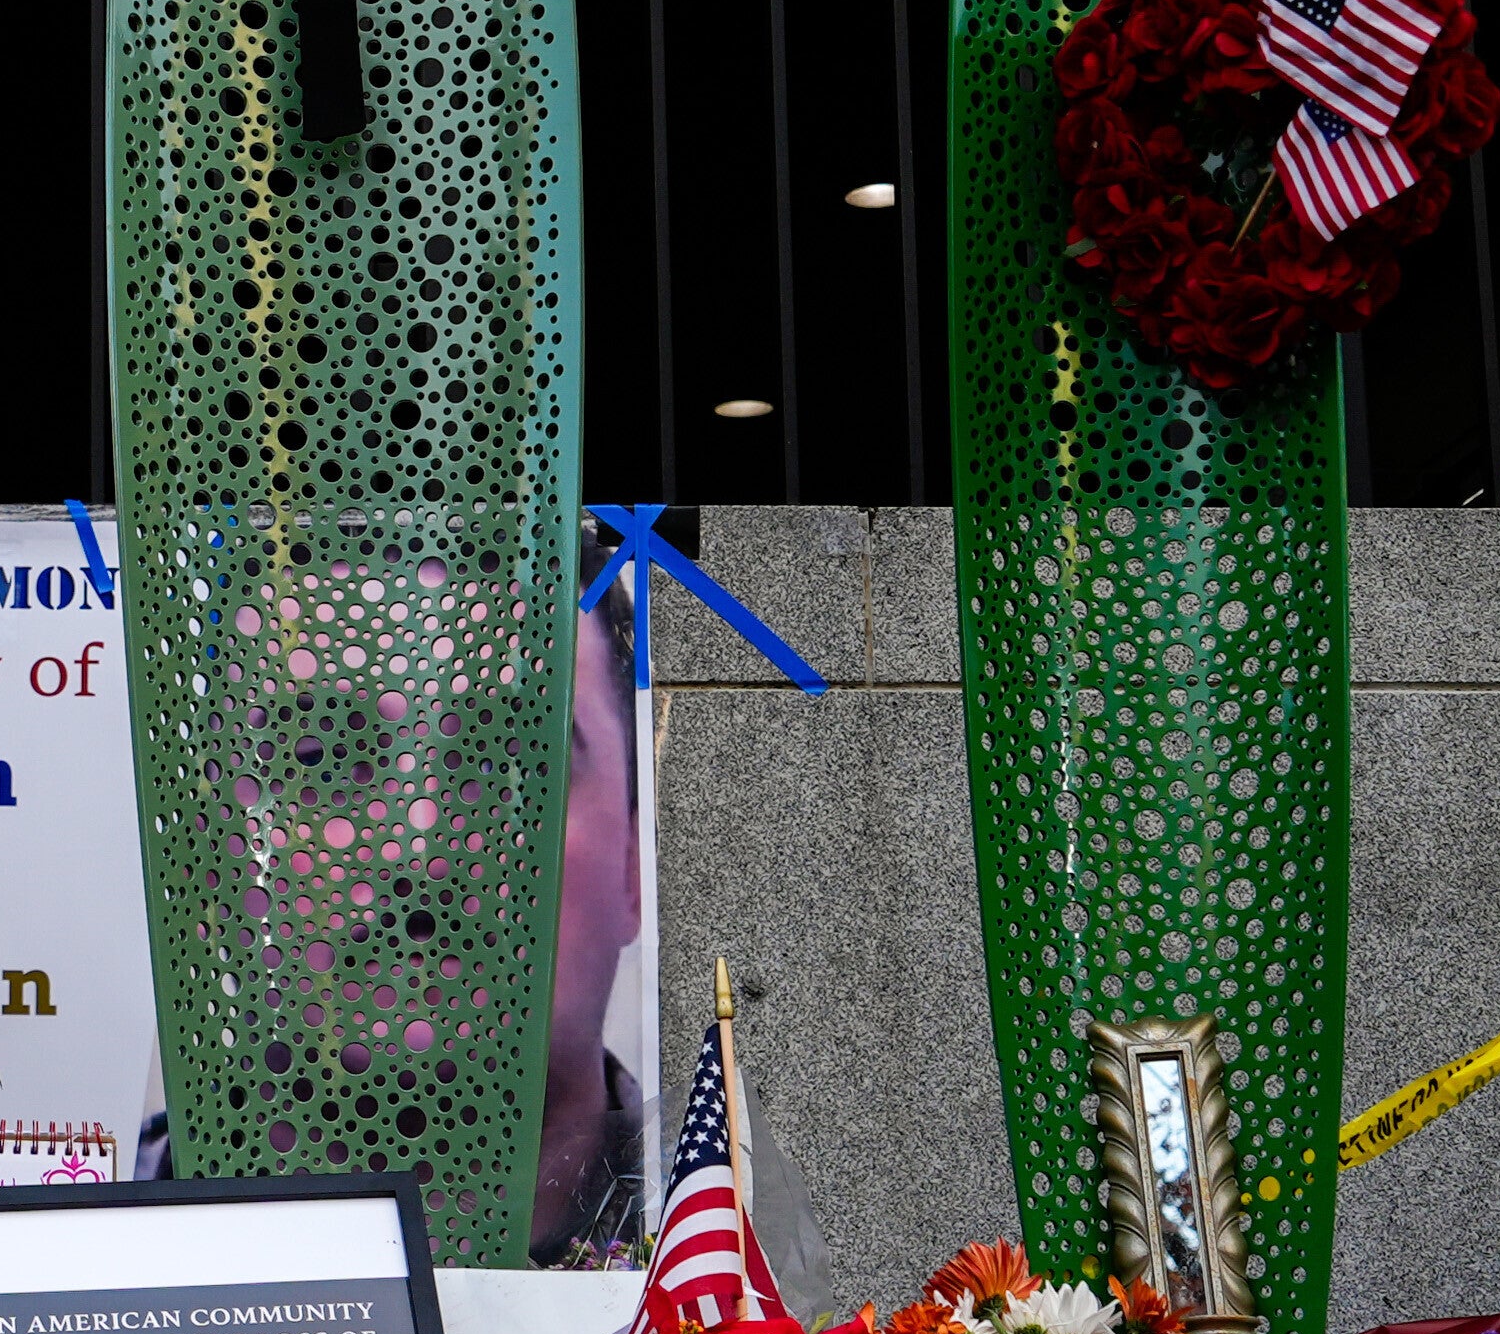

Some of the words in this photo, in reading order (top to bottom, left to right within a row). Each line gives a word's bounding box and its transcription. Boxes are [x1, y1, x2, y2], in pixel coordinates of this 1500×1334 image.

[29, 641, 105, 697] of
[26, 1309, 182, 1334] AMERICAN
[189, 1301, 375, 1327] COMMUNITY
